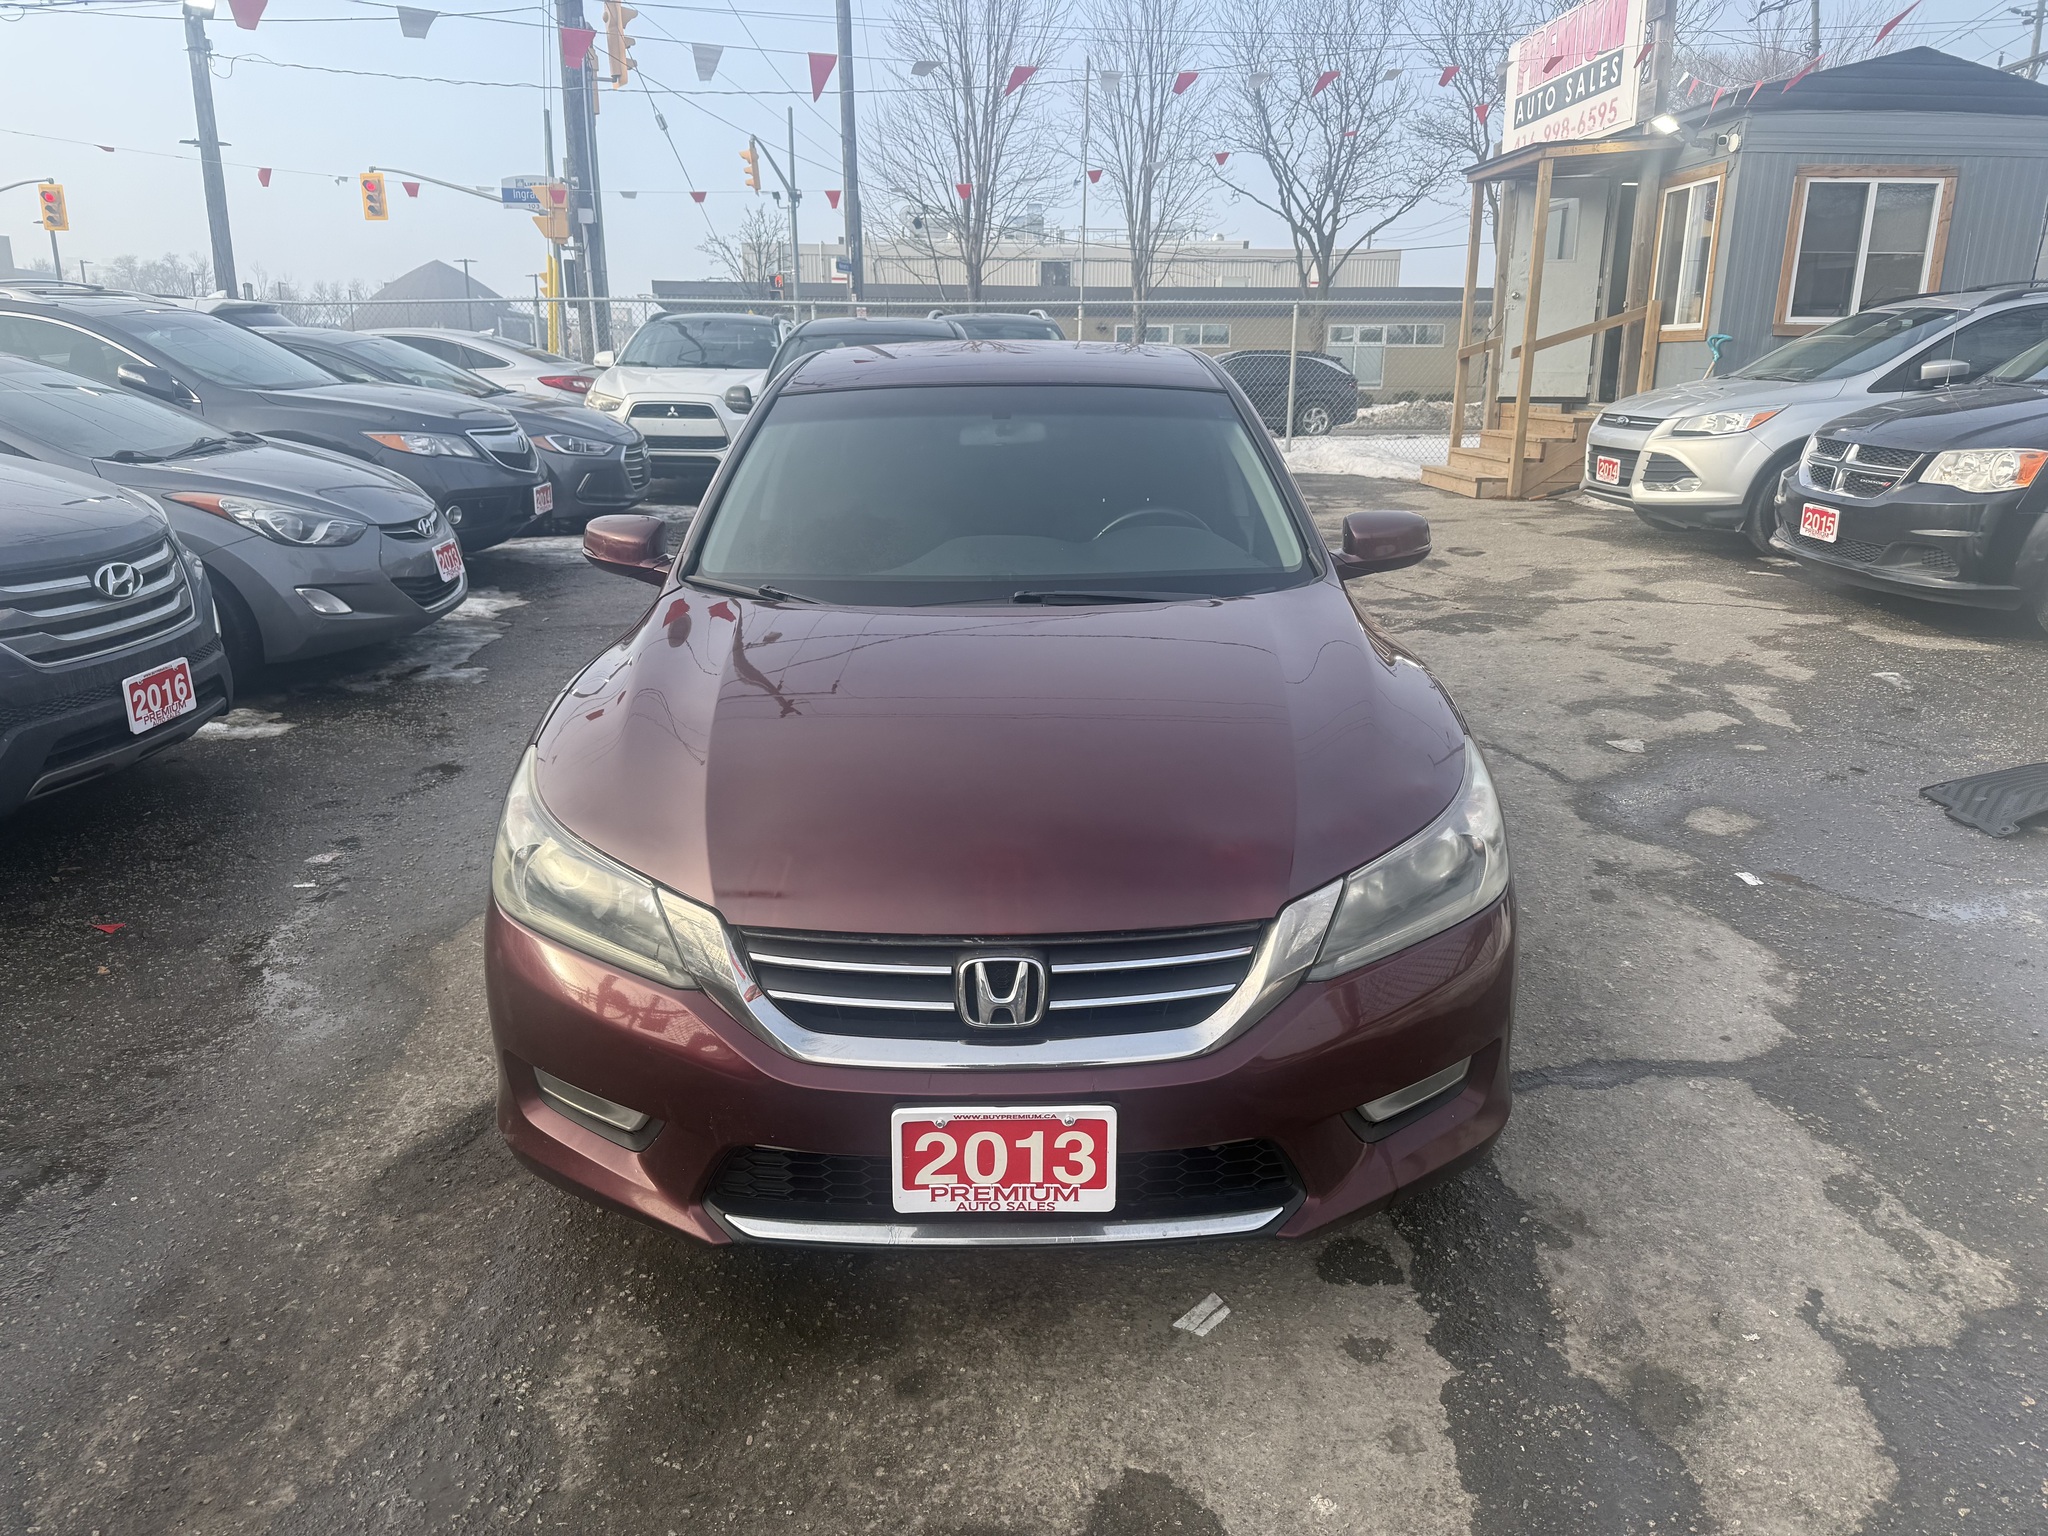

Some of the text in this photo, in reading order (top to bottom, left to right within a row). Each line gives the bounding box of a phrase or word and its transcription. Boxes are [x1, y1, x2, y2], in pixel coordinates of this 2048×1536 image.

[1515, 56, 1620, 125] AUTO SALES
[1543, 97, 1619, 142] 998-6595
[513, 189, 538, 201] Ingra
[1600, 462, 1618, 477] 2014
[1804, 511, 1835, 534] 2015
[438, 547, 460, 571] 2013
[133, 673, 187, 719] 2016
[143, 700, 187, 725] PREMIUM
[914, 1130, 1096, 1185] 2013
[930, 1183, 1081, 1203] PREMIUM
[956, 1201, 1056, 1212] AUTO SALES
